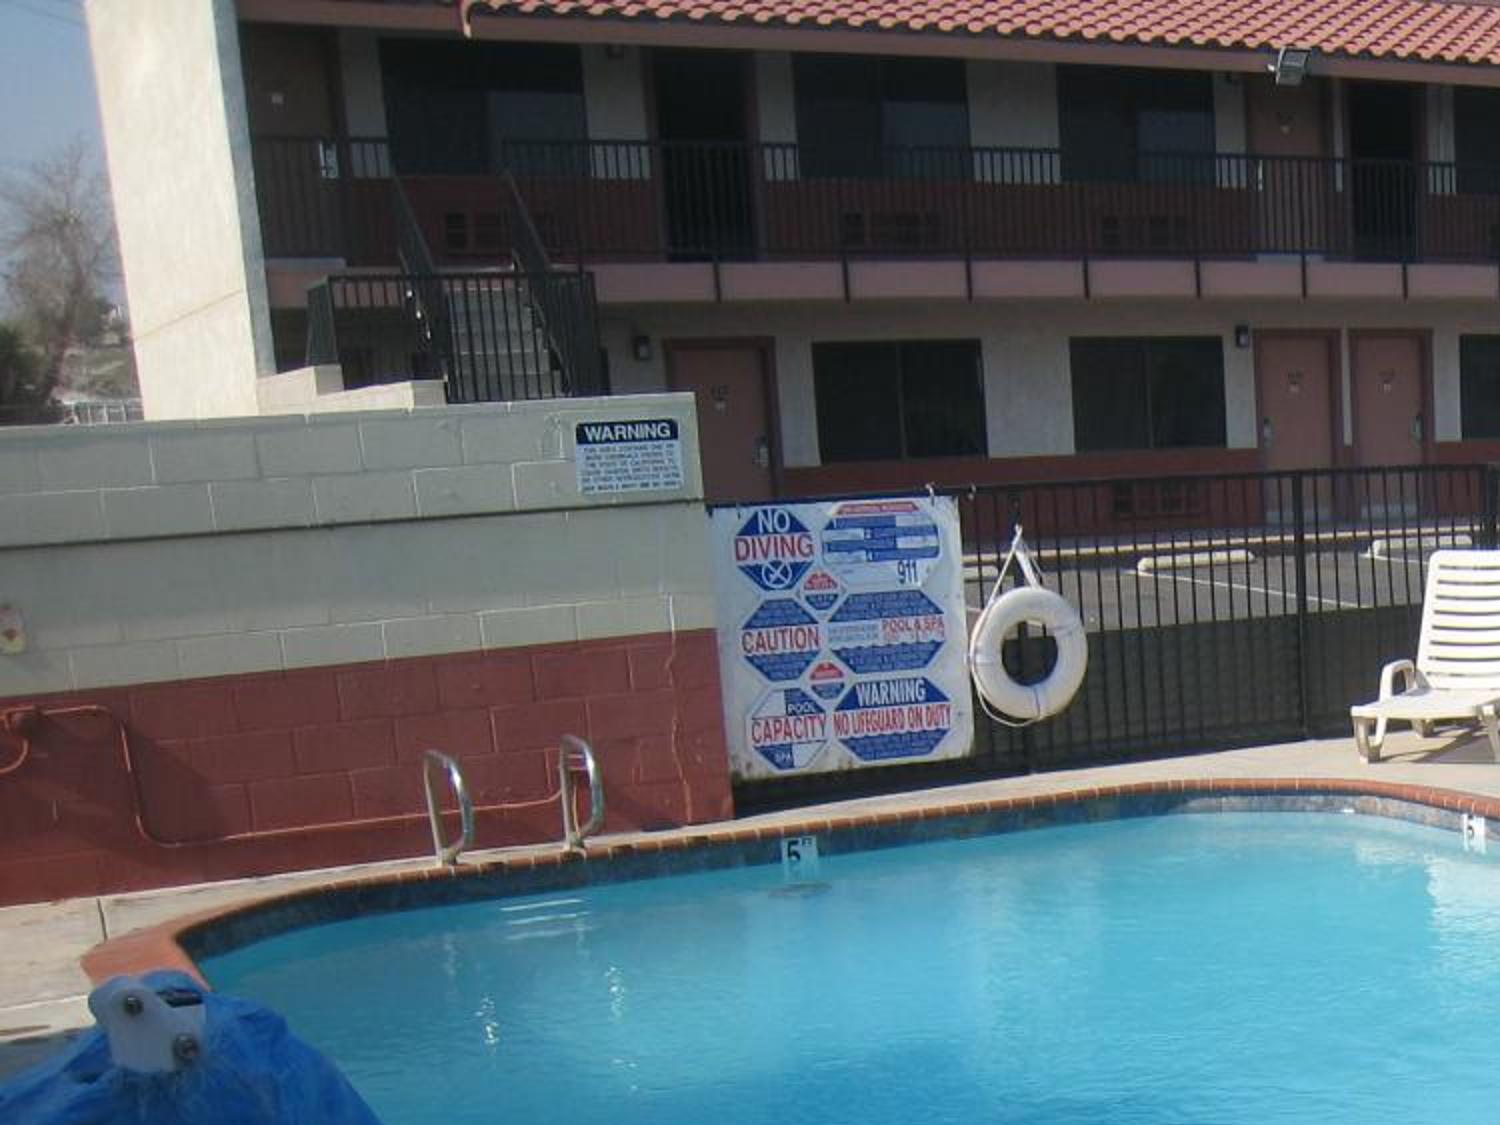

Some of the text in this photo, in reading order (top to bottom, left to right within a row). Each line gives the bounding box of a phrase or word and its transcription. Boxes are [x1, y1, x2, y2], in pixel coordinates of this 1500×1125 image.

[584, 421, 671, 441] WARNING
[757, 509, 791, 534] NO
[736, 534, 815, 561] DIVING
[897, 561, 918, 585] 911
[742, 626, 819, 654] CAUTION
[856, 678, 927, 707] WARNING
[787, 701, 816, 714] POOL
[833, 704, 951, 736] NO LIFEGUARD ON DUTY
[752, 715, 826, 744] CAPACITY
[787, 839, 801, 862] 5
